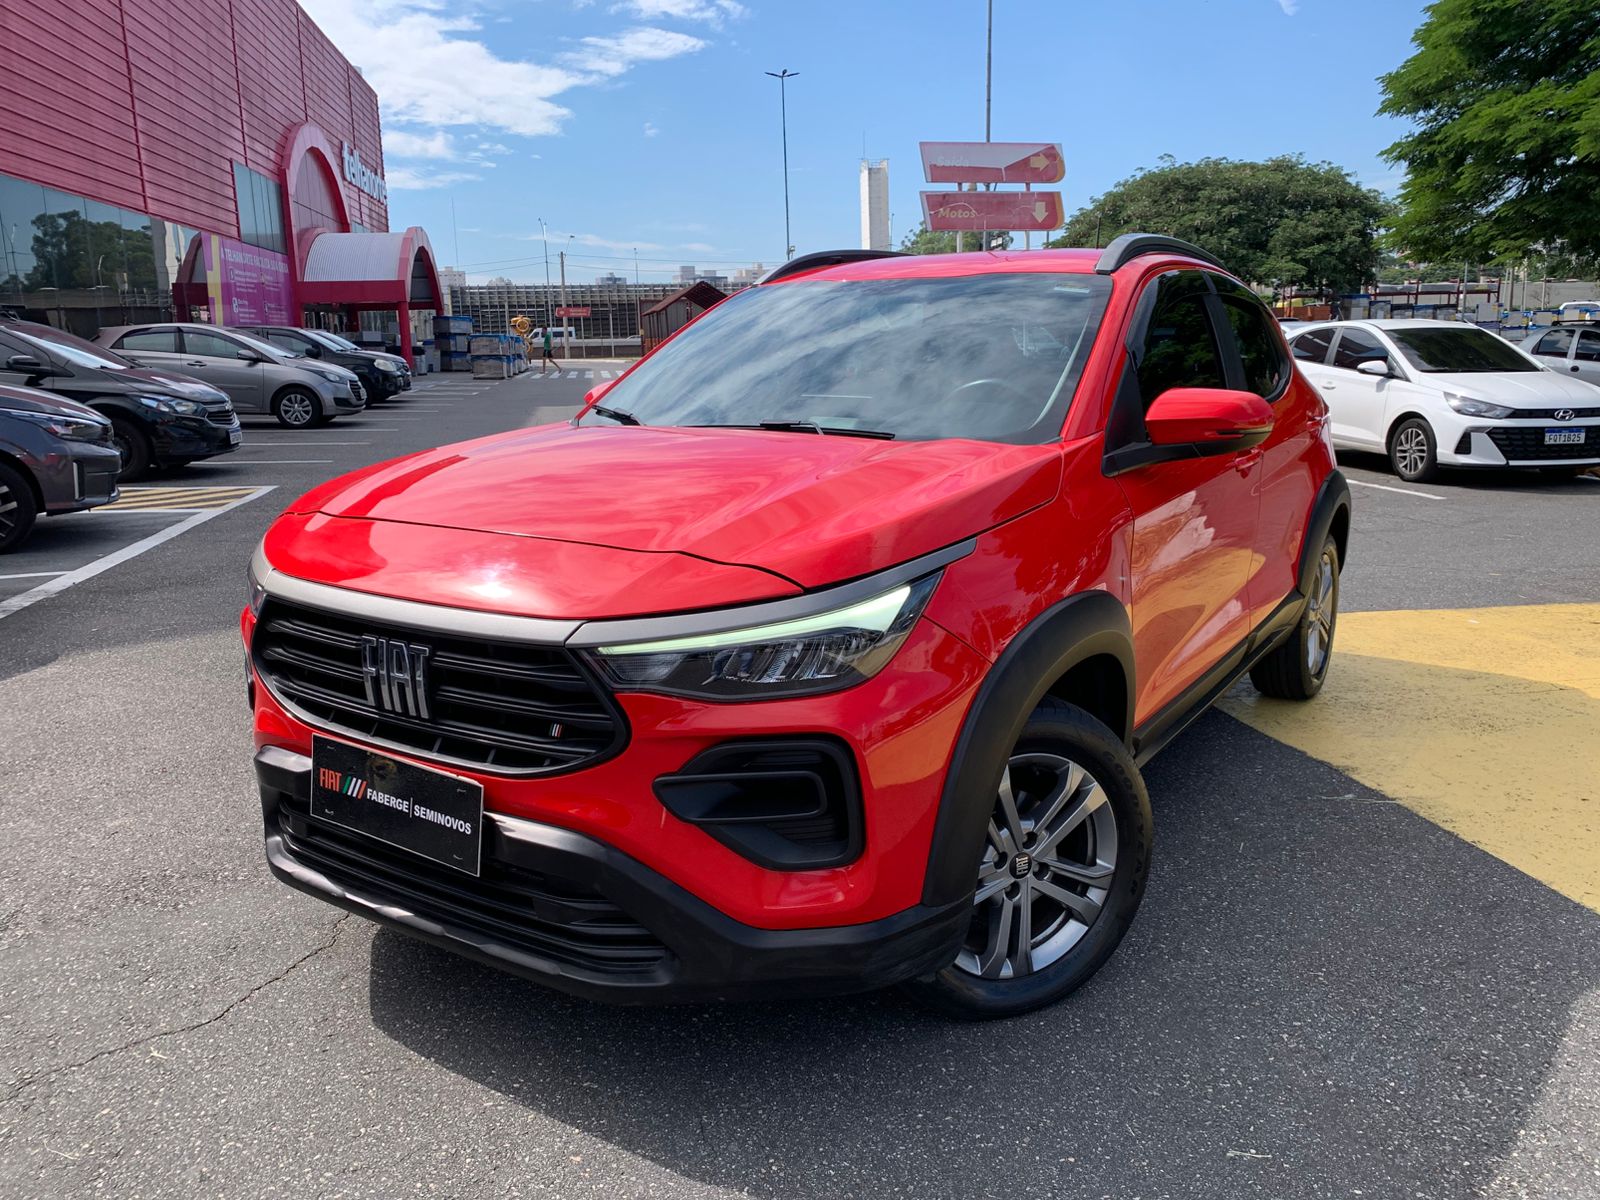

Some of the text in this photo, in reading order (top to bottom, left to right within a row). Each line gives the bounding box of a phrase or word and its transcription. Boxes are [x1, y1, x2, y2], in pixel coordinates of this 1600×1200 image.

[937, 208, 976, 219] Motos
[360, 635, 430, 720] FIAT
[319, 767, 472, 835] FIAT FABERGE SEMINOVOS
[1015, 856, 1029, 876] FIAT
